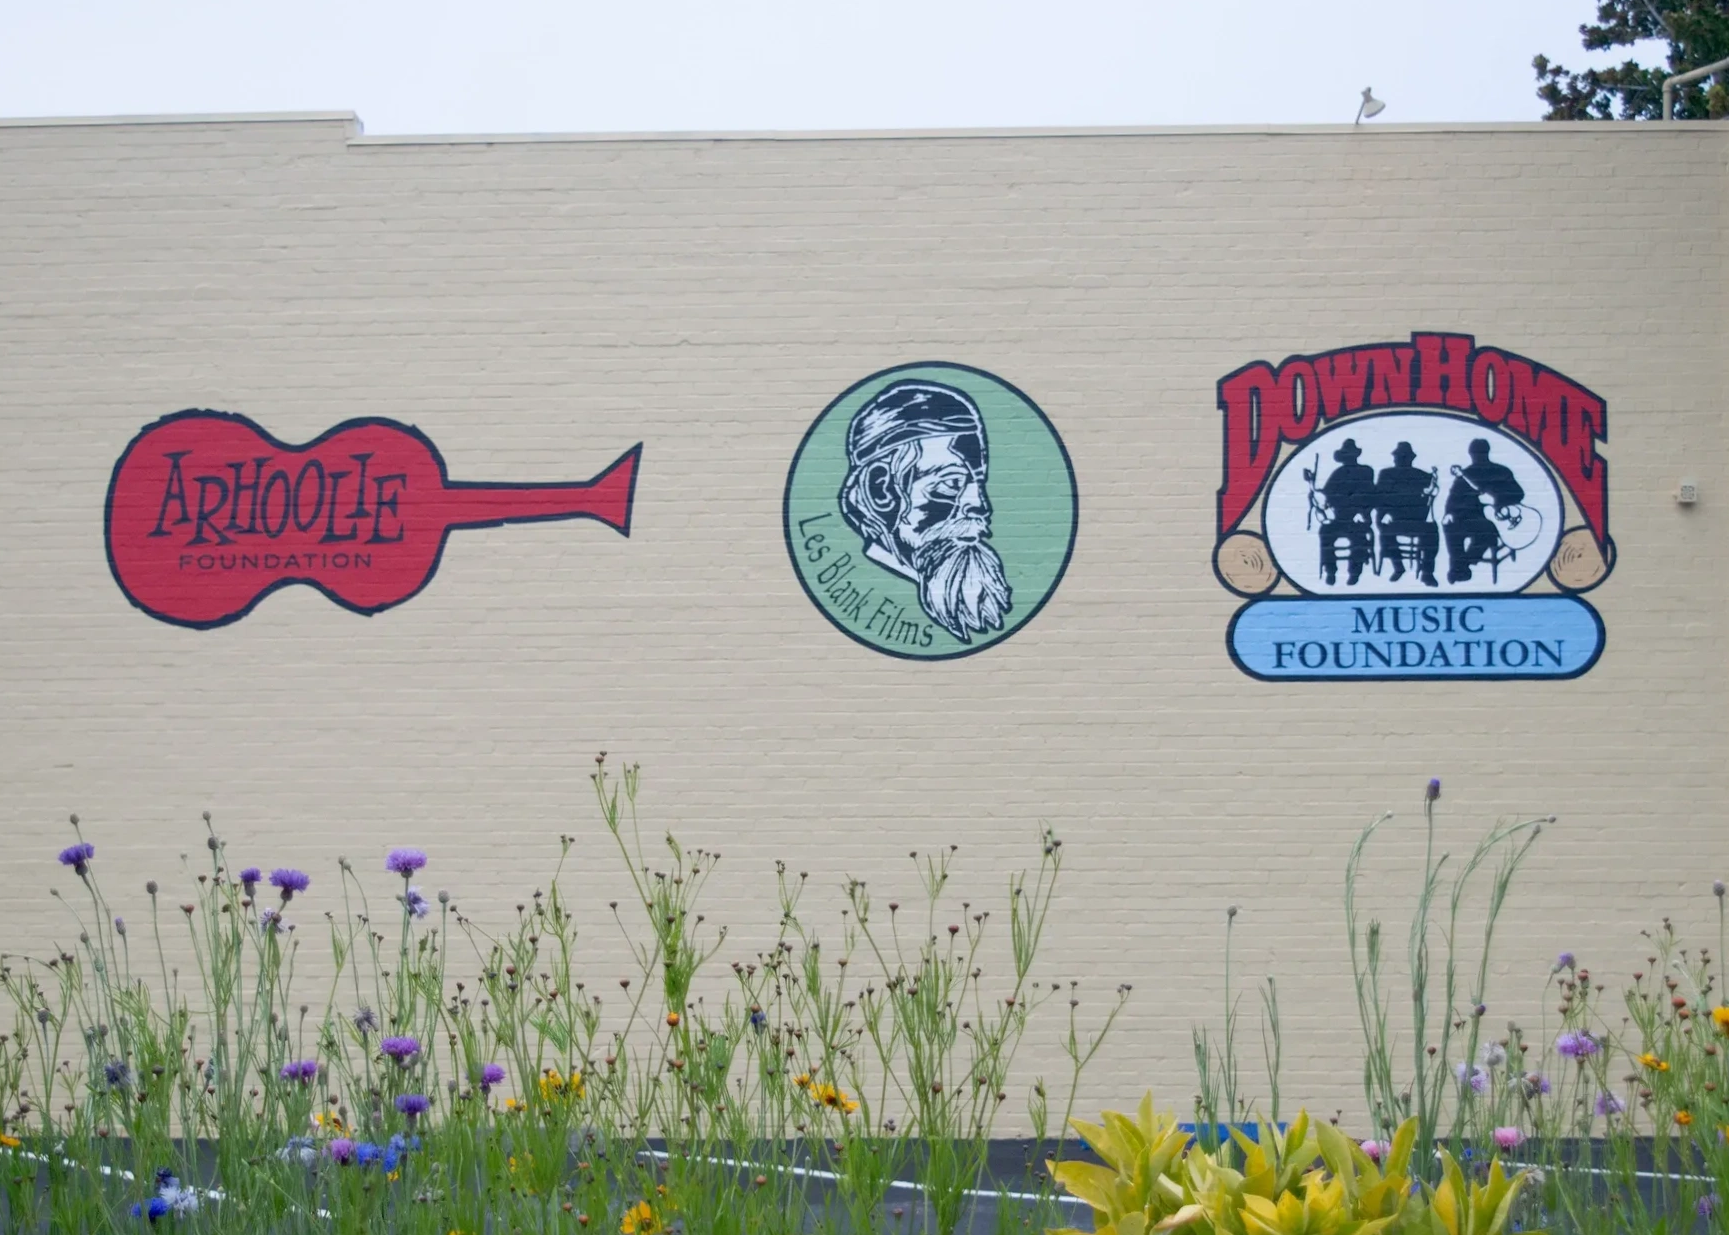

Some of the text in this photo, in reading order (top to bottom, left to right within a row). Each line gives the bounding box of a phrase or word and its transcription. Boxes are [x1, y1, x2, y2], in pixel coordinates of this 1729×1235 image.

[146, 450, 407, 546] ARHOOLIE
[178, 551, 373, 571] FOUNDATION
[798, 512, 933, 647] Les Blank Films
[1351, 605, 1485, 634] MUSIC
[1272, 639, 1565, 669] FOUNDATION
